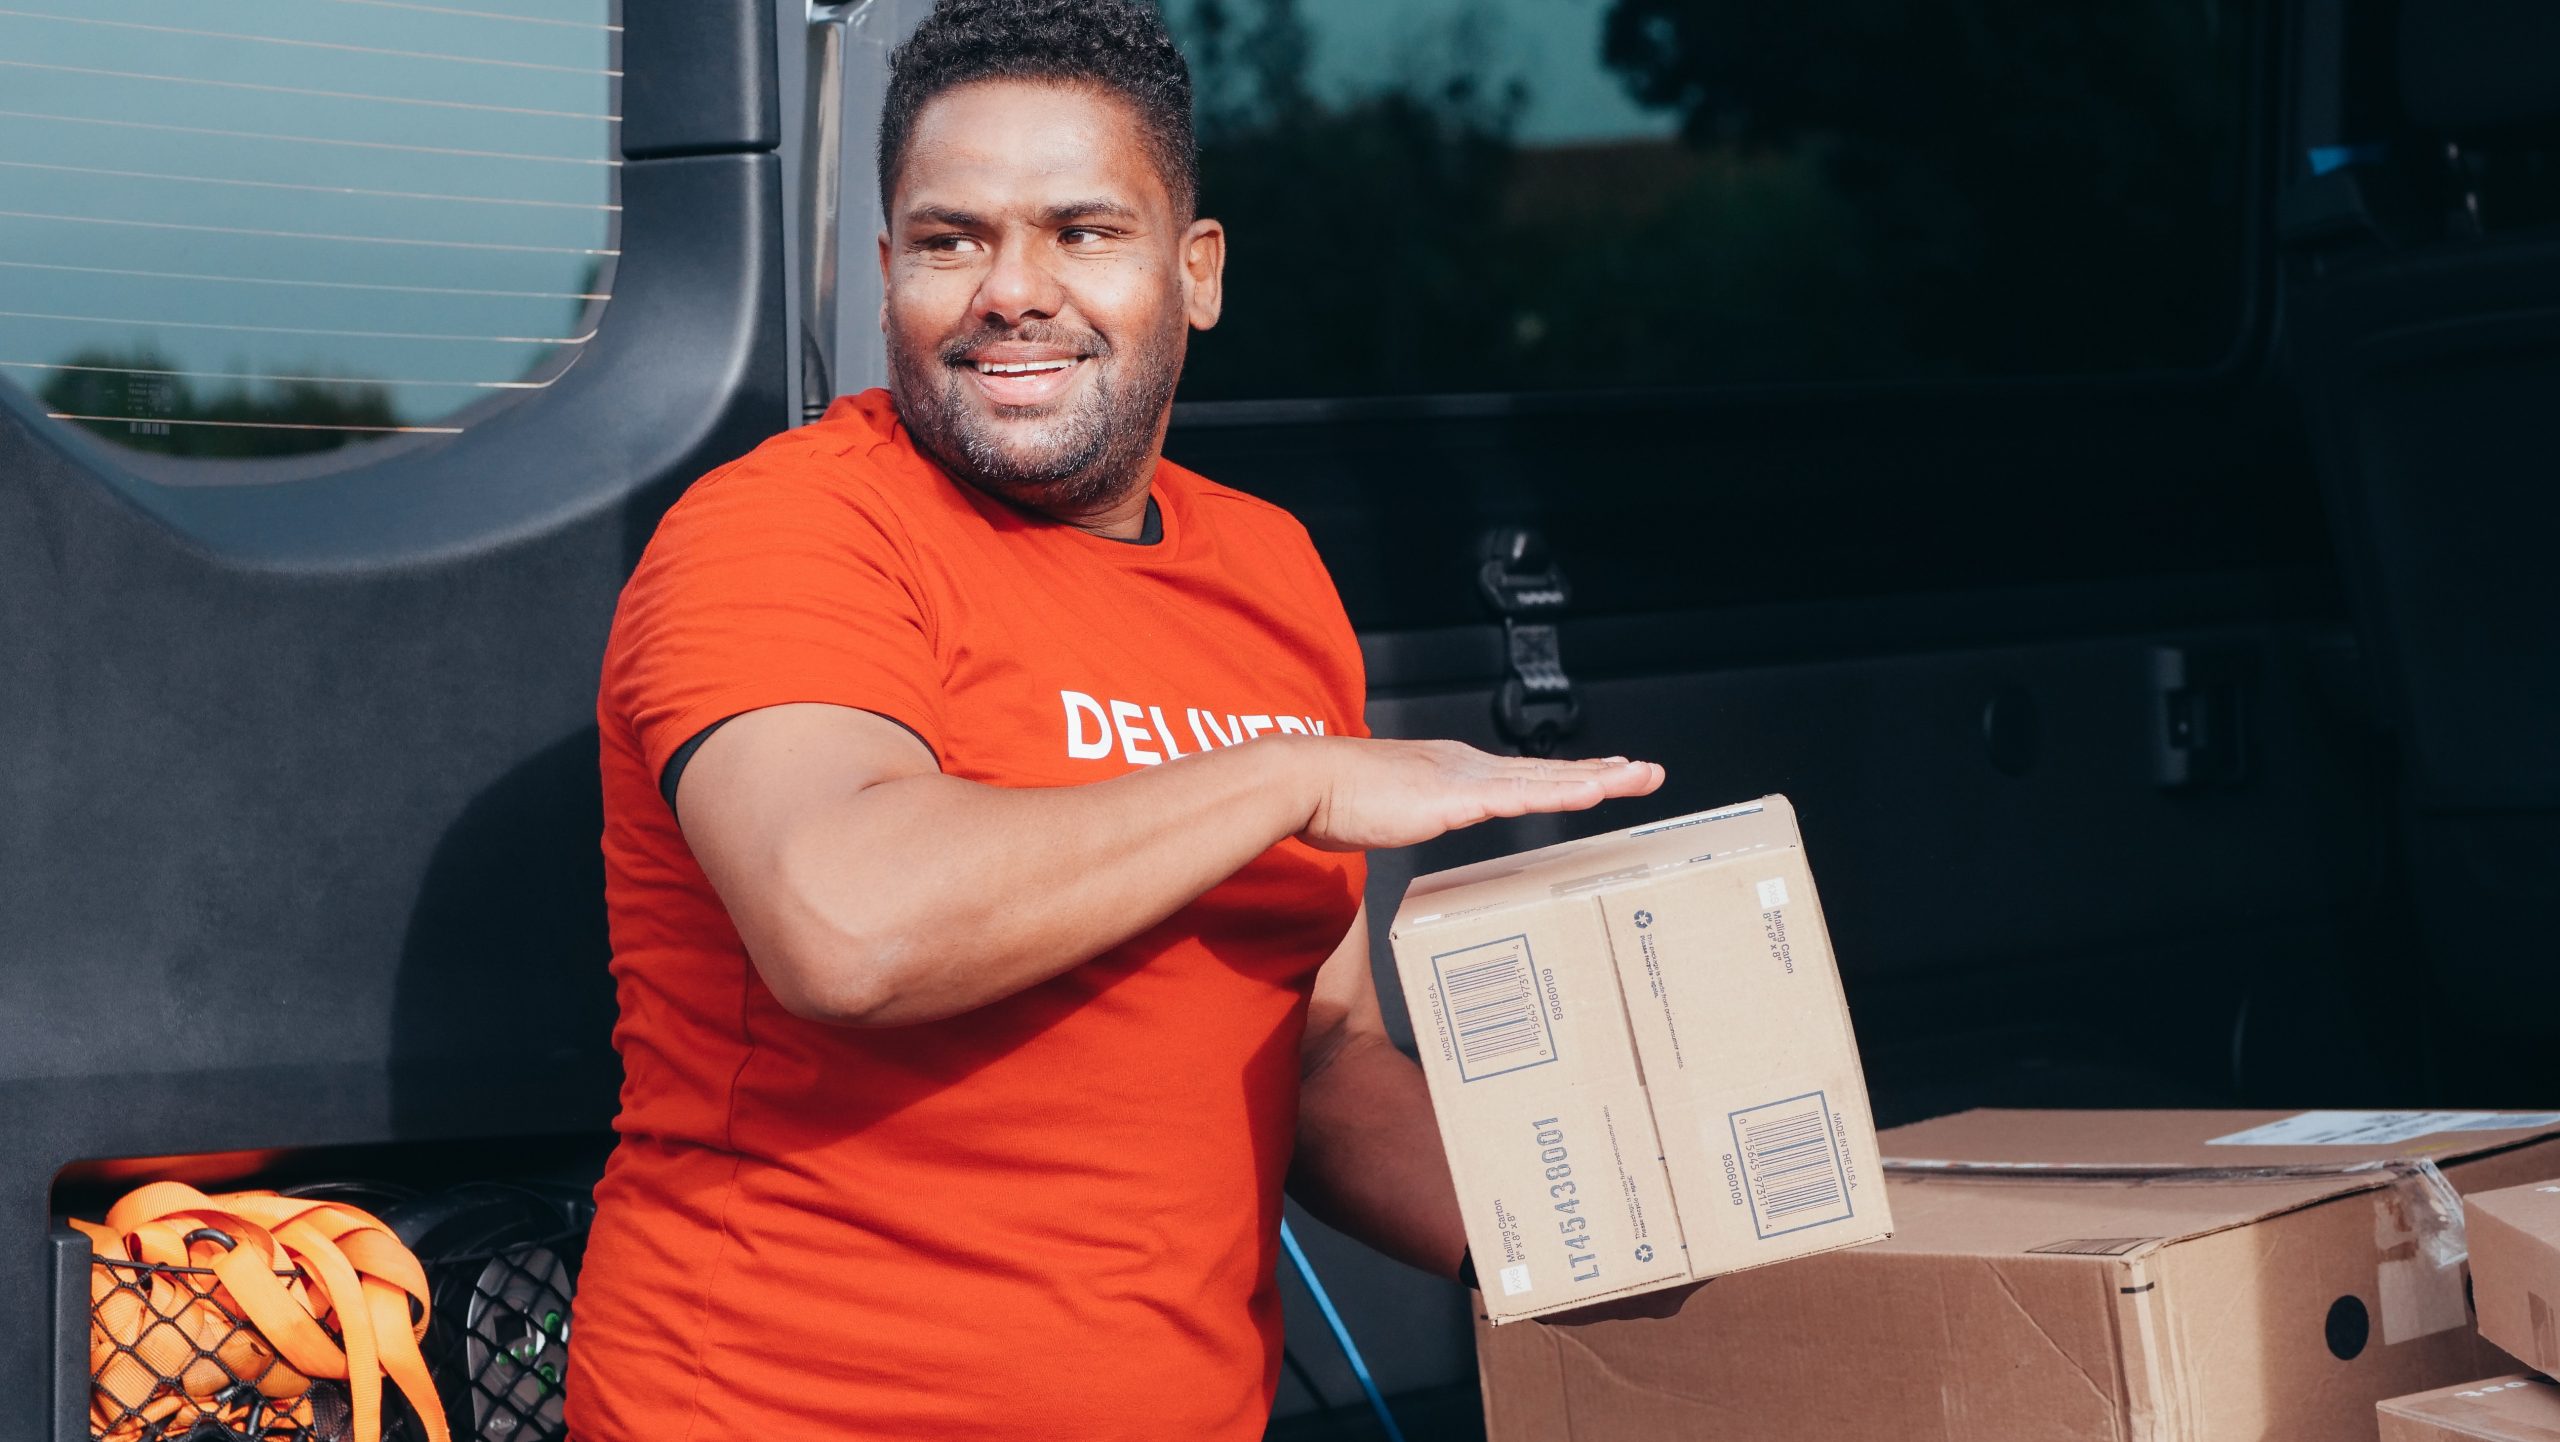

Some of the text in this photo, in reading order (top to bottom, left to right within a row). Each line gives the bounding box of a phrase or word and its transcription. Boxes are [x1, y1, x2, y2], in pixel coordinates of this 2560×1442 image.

[1766, 881, 1779, 904] XXS
[1639, 934, 1648, 954] Please
[1770, 909, 1795, 974] Mailing Carton
[1643, 954, 1653, 975] recycle
[1516, 967, 1531, 998] 97311
[1542, 967, 1563, 1021] 93060109
[1648, 946, 1659, 970] package
[1664, 1008, 1678, 1050] post-consumer
[1427, 982, 1453, 1061] MADE IN THE U.S.A.
[1525, 1002, 1541, 1034] 15645
[1606, 1123, 1622, 1165] post-consumer
[1832, 1112, 1857, 1190] MADE IN THE U.S.A.
[1617, 1166, 1625, 1180] from
[1721, 1152, 1743, 1205] 93060109
[1744, 1138, 1759, 1170] 15645
[1753, 1175, 1768, 1207] 97311
[1533, 1116, 1600, 1282] LT45438001
[1627, 1202, 1639, 1226] package
[1633, 1197, 1643, 1218] recycle
[1492, 1199, 1517, 1263] Mailing Carton
[1633, 1227, 1641, 1239] This
[1638, 1219, 1647, 1237] Please
[1508, 1267, 1522, 1290] XXS
